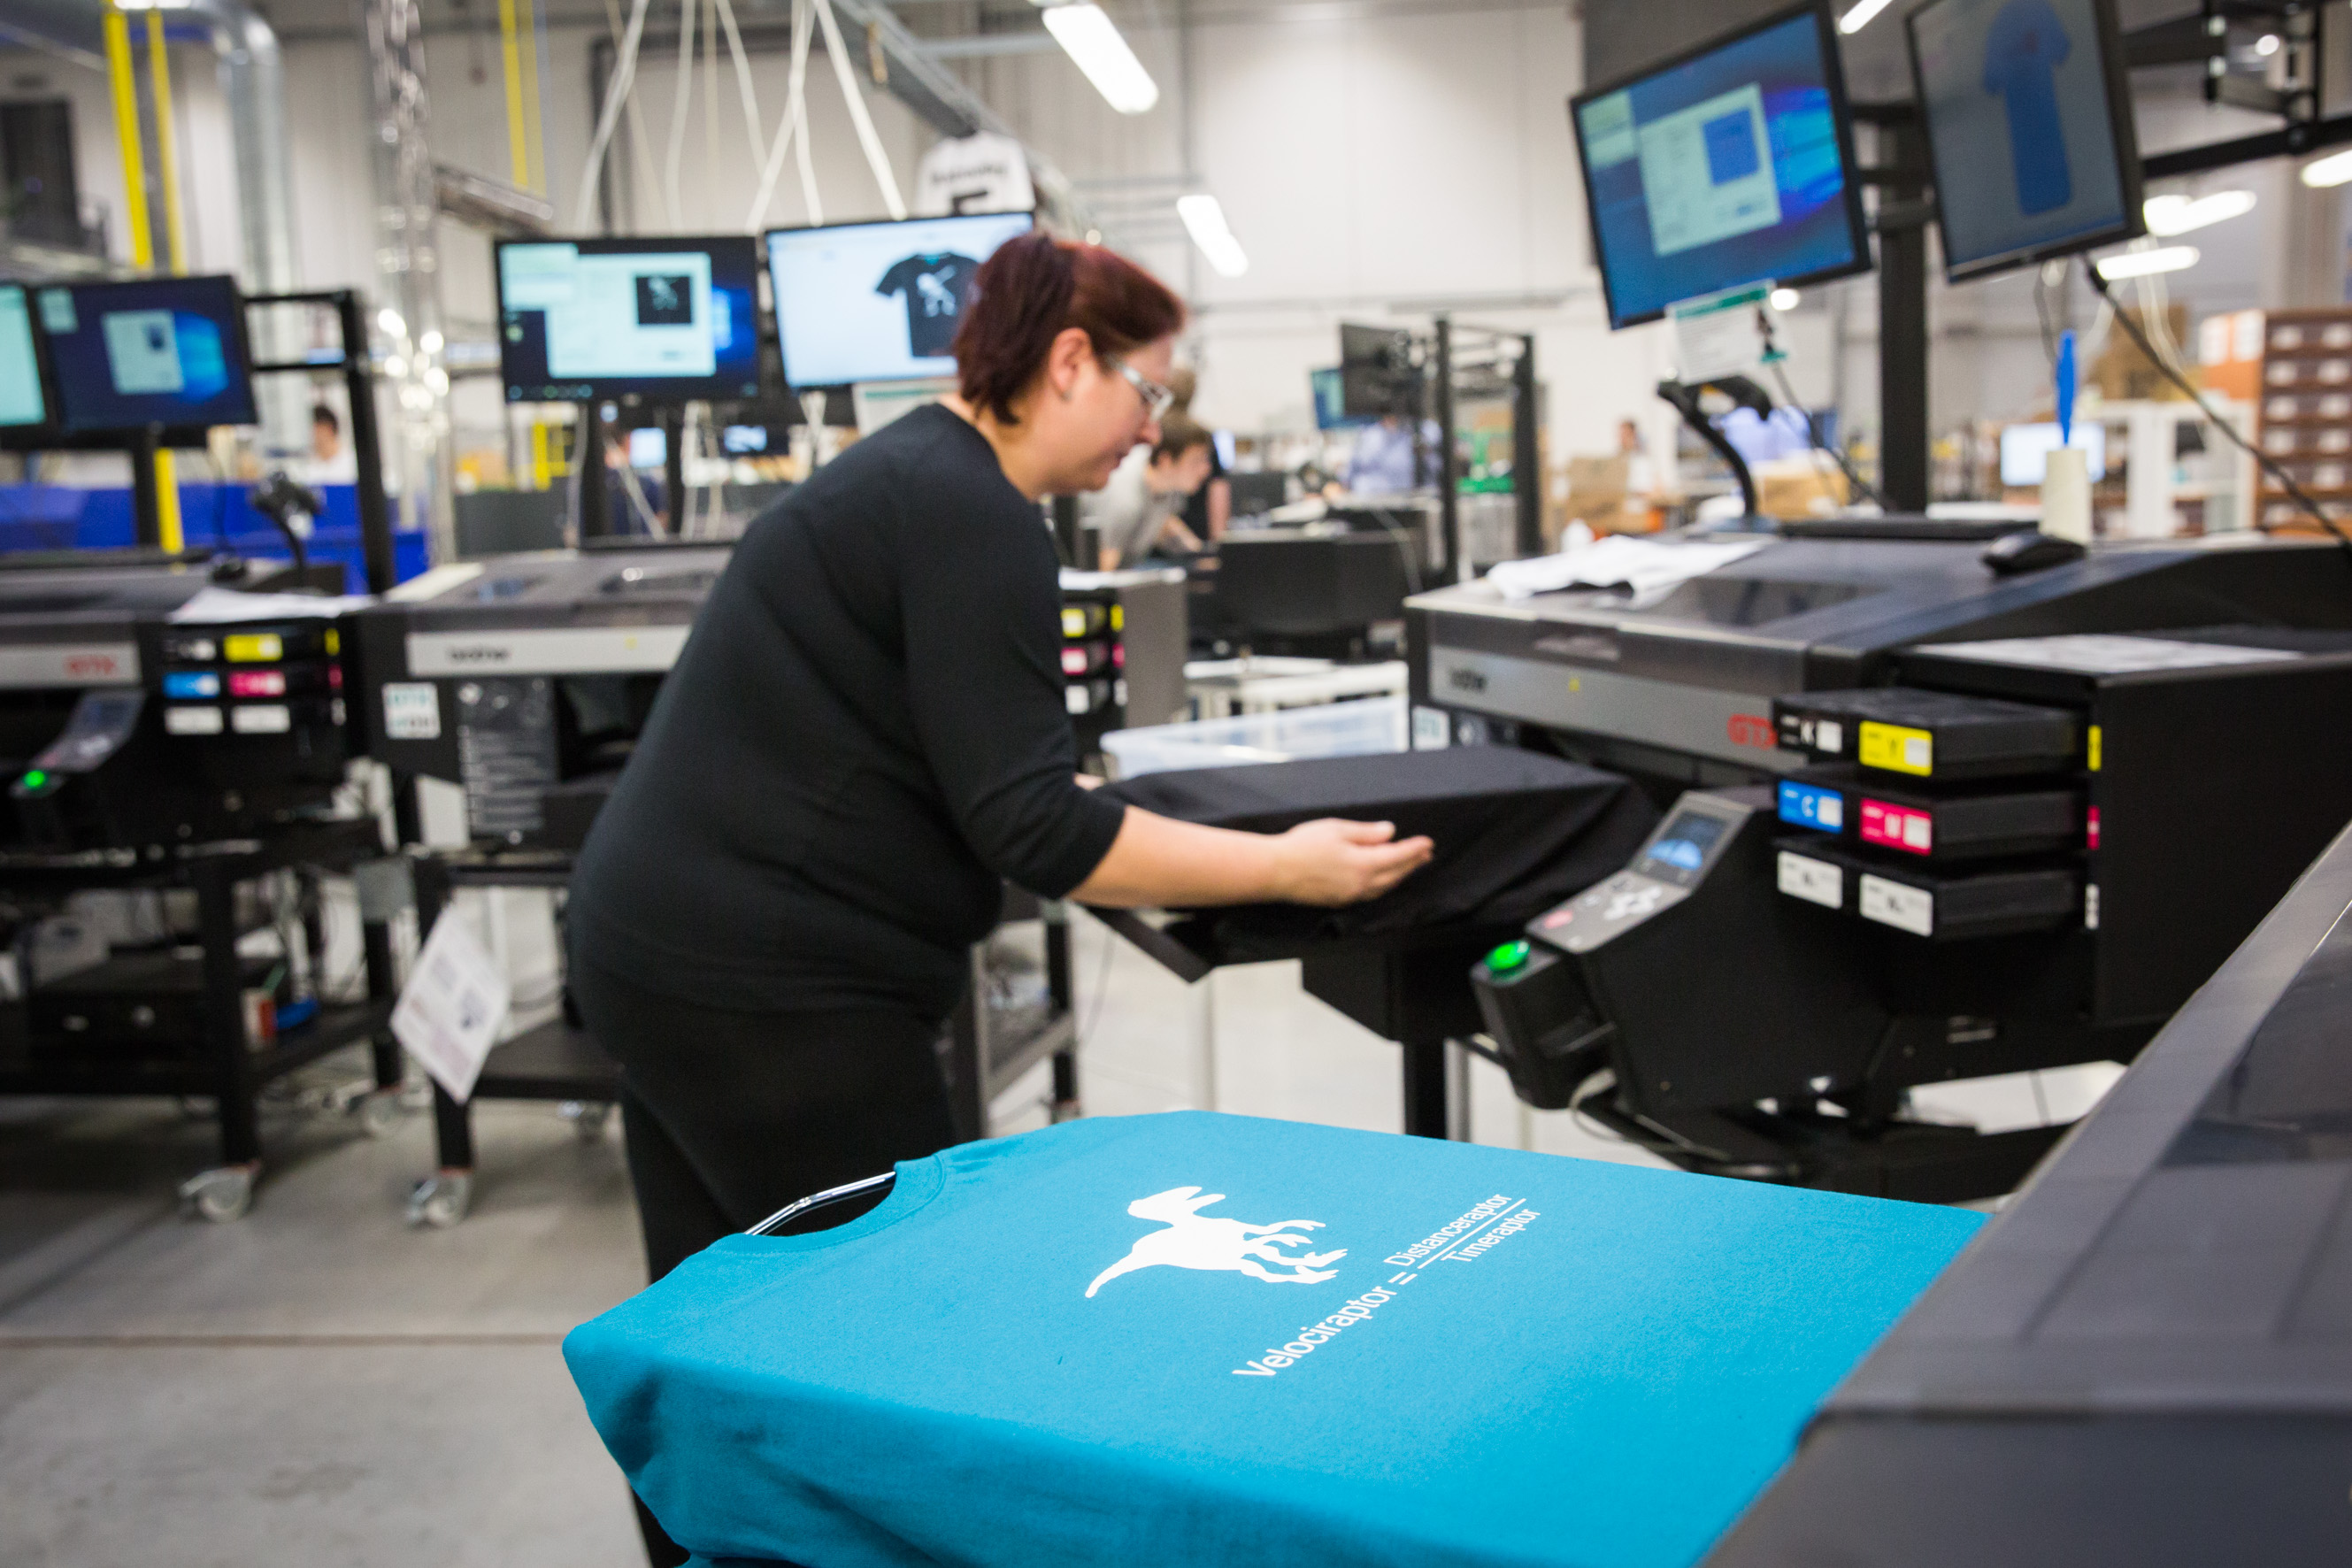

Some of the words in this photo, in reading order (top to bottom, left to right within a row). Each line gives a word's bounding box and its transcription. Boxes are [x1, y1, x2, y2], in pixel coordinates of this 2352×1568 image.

[1383, 1194, 1512, 1266] Distanceraptor
[1441, 1209, 1541, 1262] Timeraptor
[1232, 1286, 1397, 1377] Velociraptor
